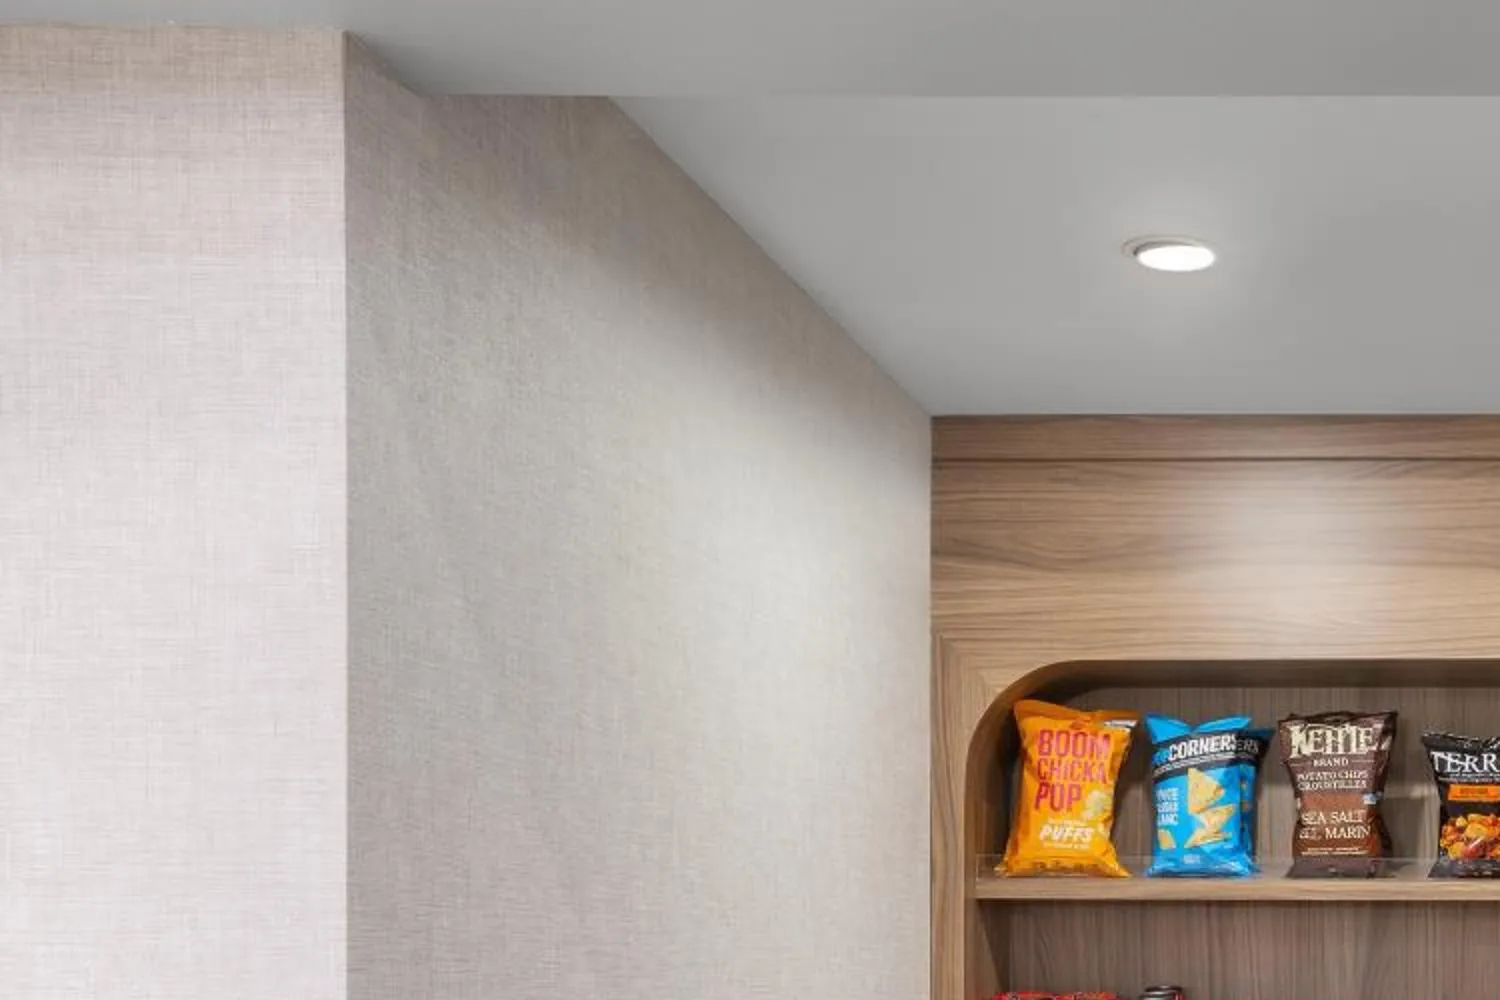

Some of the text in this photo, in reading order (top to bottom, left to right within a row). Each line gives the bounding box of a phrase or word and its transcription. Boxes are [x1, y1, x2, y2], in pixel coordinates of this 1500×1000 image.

[1037, 729, 1112, 760] BOOM
[1036, 757, 1108, 785] CHICKA
[1313, 757, 1349, 767] BRAND
[1034, 781, 1083, 812] POP
[1301, 809, 1368, 825] SEA SALT
[1038, 823, 1095, 843] PUFFS
[1325, 825, 1372, 840] MARIN
